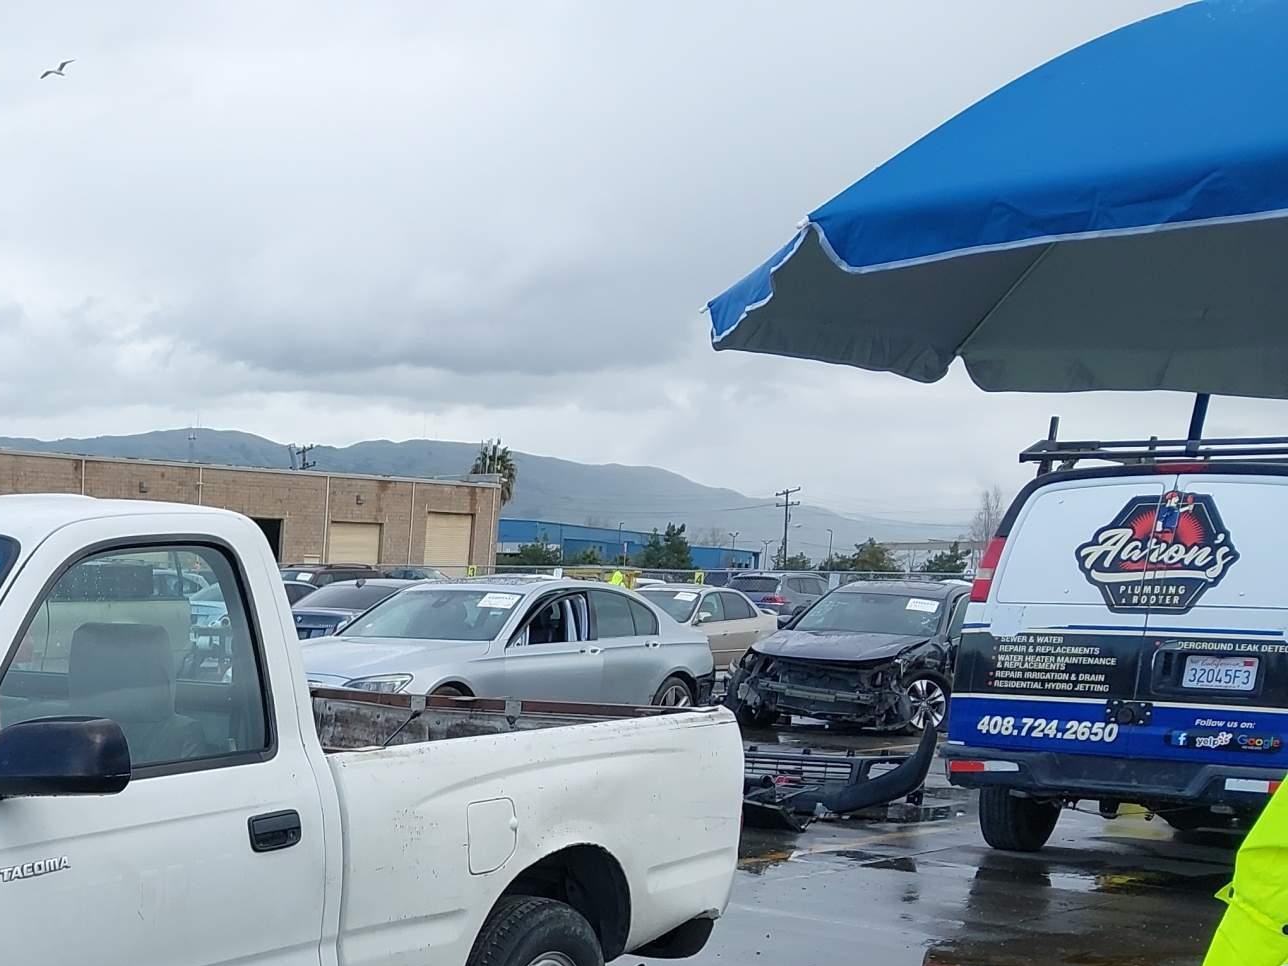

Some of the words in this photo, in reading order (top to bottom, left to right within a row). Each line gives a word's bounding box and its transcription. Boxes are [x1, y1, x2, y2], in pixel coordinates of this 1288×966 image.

[1080, 528, 1234, 578] Aaron's
[1119, 585, 1186, 594] PLUMBING
[1132, 595, 1179, 604] ROOTER
[1036, 636, 1063, 644] WATER
[999, 645, 1027, 653] REPAIR
[1028, 645, 1034, 653] &
[1035, 646, 1100, 655] REPLACEMENTS
[1178, 641, 1234, 651] DERGROUND
[1235, 643, 1259, 652] LEAK
[1004, 661, 1066, 671] REPLACEMENTS
[1025, 655, 1055, 663] HEATER
[1056, 656, 1117, 666] MAINTENANCE
[995, 671, 1023, 679] REPAIR
[1024, 672, 1070, 681] IRRIGATION
[1078, 674, 1105, 682] DRAIN
[1188, 668, 1251, 685] 32045F3
[994, 680, 1043, 689] RESIDENTIAL
[1045, 681, 1073, 691] HYDRO
[1074, 684, 1110, 692] JETTING
[977, 715, 1119, 742] 408.724.2650
[1194, 718, 1225, 728] Follow
[1226, 720, 1238, 728] us
[1237, 734, 1281, 749] Google
[0, 856, 71, 882] TACOMA
